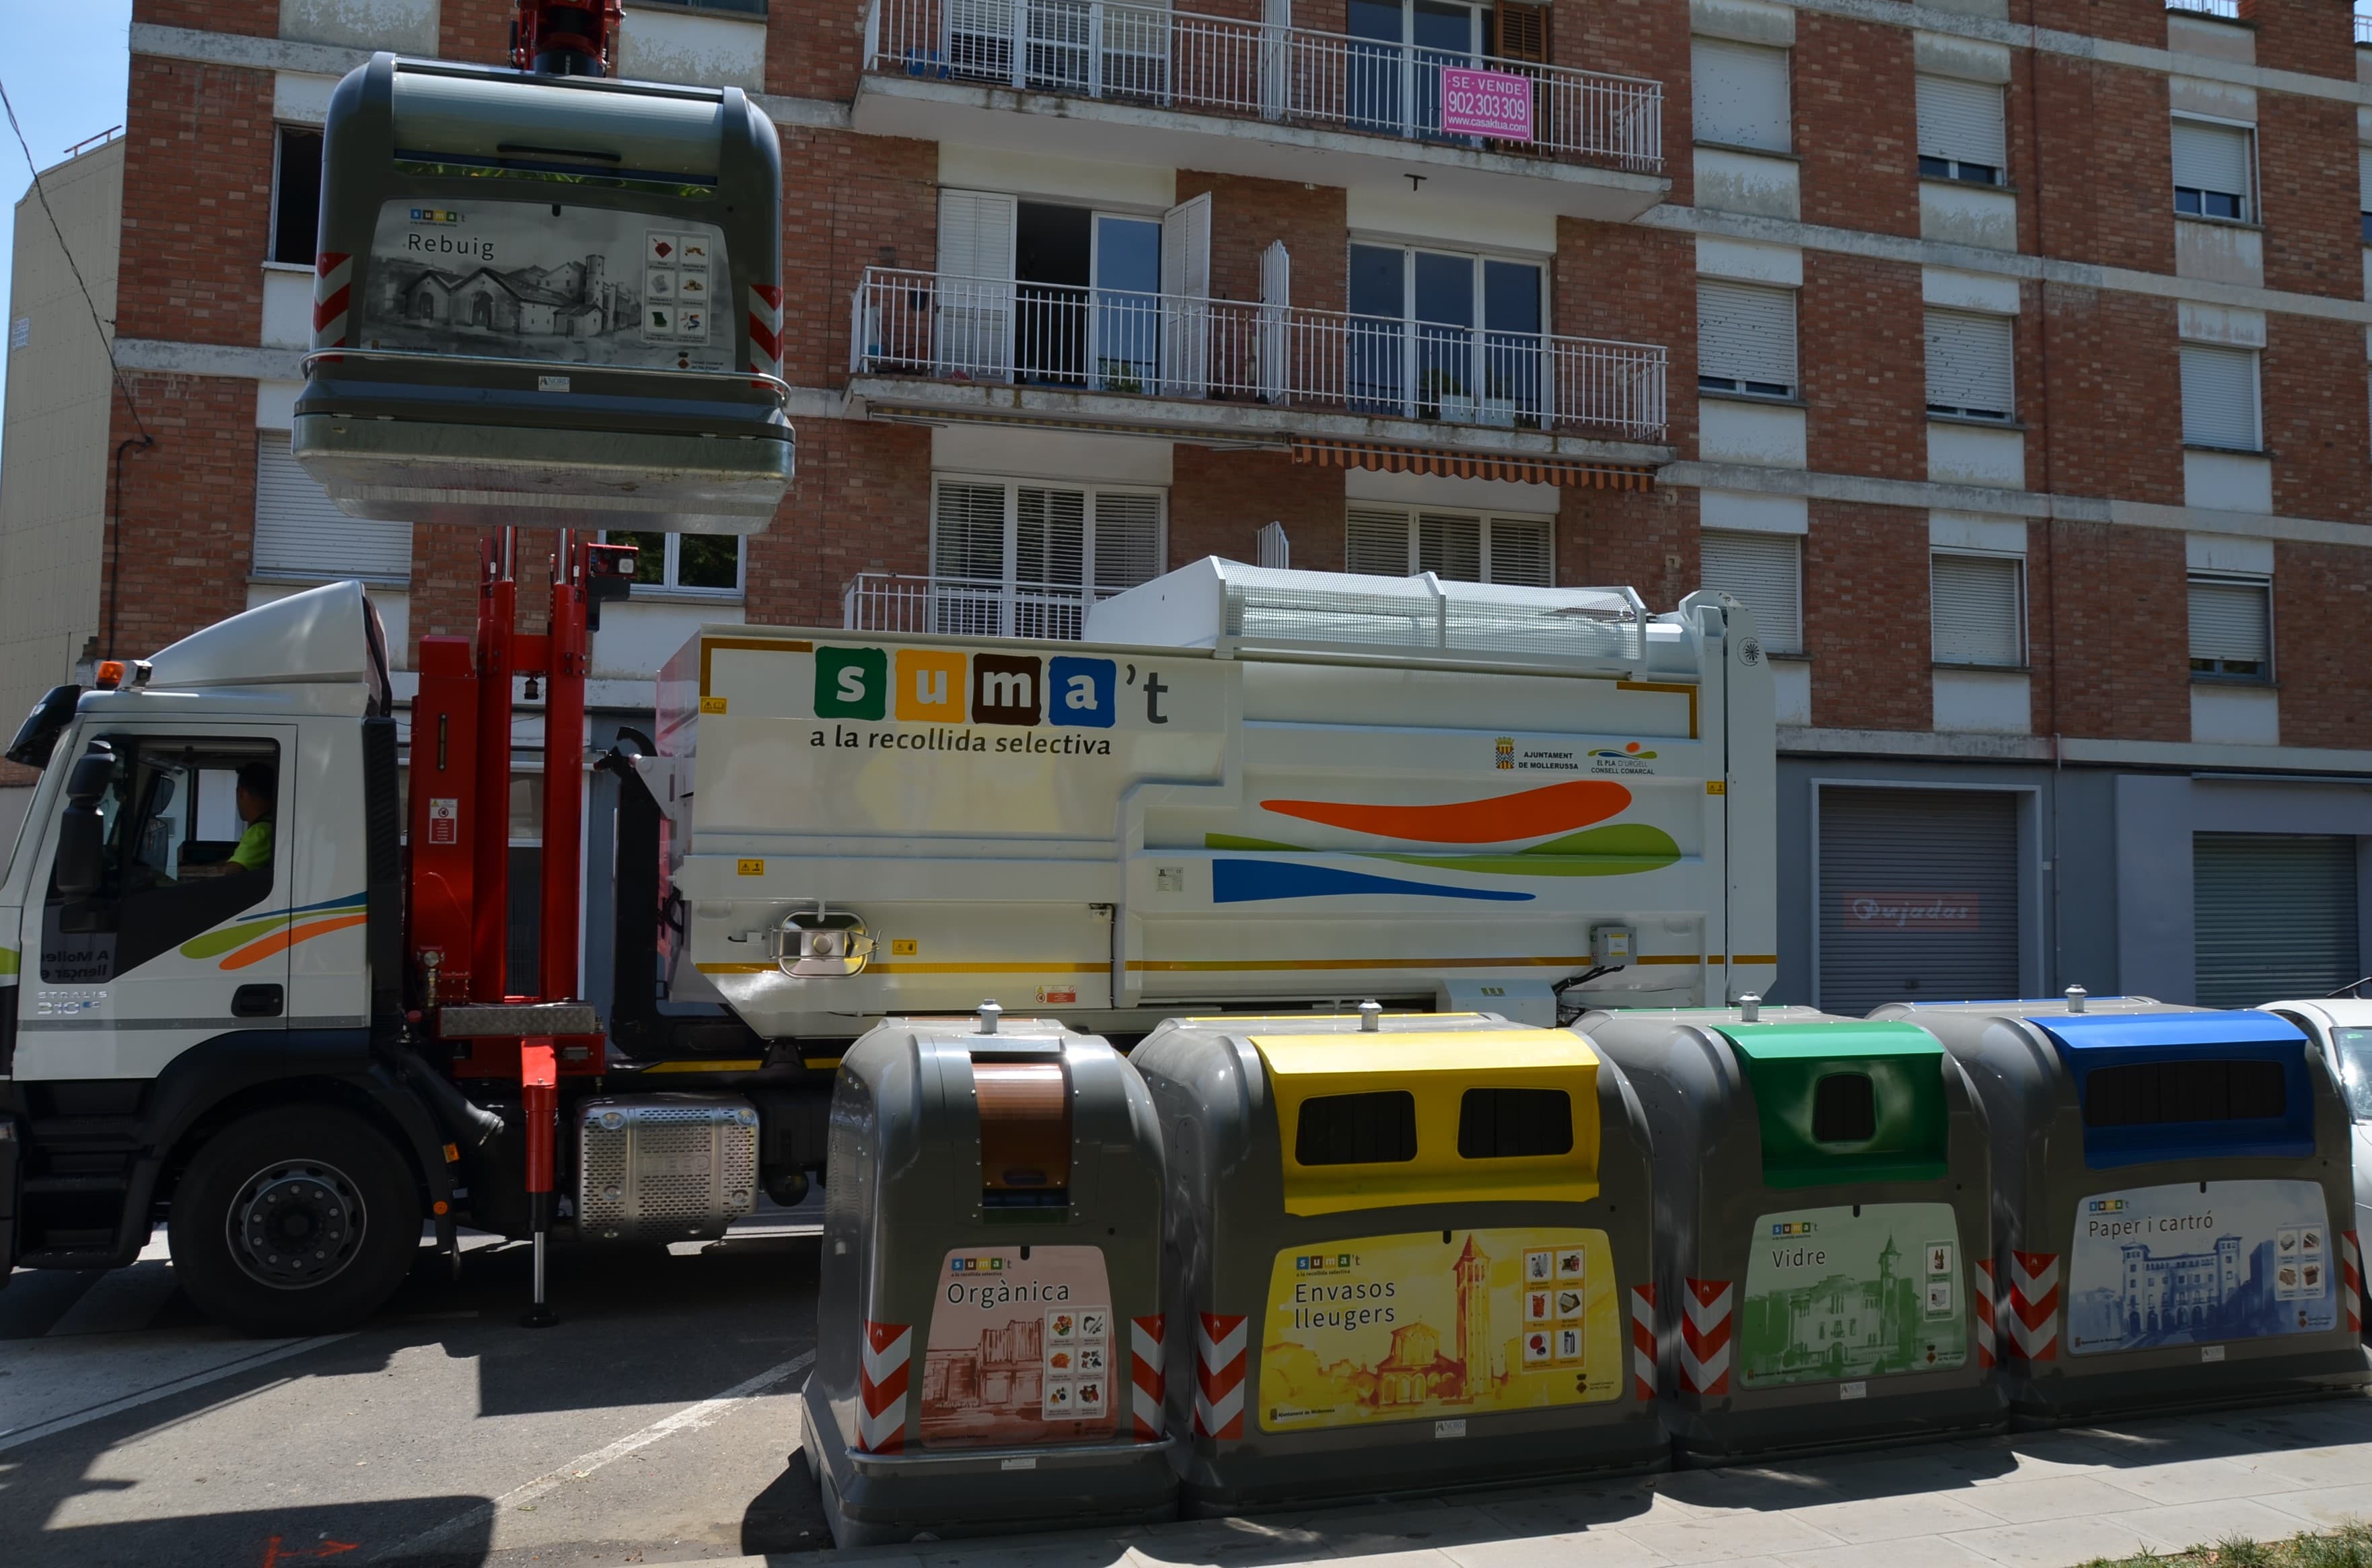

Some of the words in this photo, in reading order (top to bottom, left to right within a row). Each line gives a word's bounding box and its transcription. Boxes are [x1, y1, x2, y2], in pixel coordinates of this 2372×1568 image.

[1452, 76, 1470, 89] SE
[1478, 79, 1522, 96] VENDE
[1448, 116, 1527, 133] www.casaktua.com
[408, 234, 495, 261] Rebuig
[834, 662, 1170, 725] suma't
[810, 730, 826, 748] a
[834, 724, 859, 748] la
[868, 727, 986, 752] recollida
[995, 732, 1111, 755] selectiva
[1523, 751, 1573, 759] AJUNTAMENT
[38, 1001, 79, 1015] 310
[2089, 1221, 2141, 1240] Paper
[2148, 1216, 2152, 1233] i
[2159, 1210, 2213, 1232] cartró
[1772, 1247, 1826, 1268] Vidre
[947, 1279, 1069, 1309] Orgànica
[1296, 1282, 1395, 1304] Envasos
[1295, 1308, 1395, 1330] lleugers
